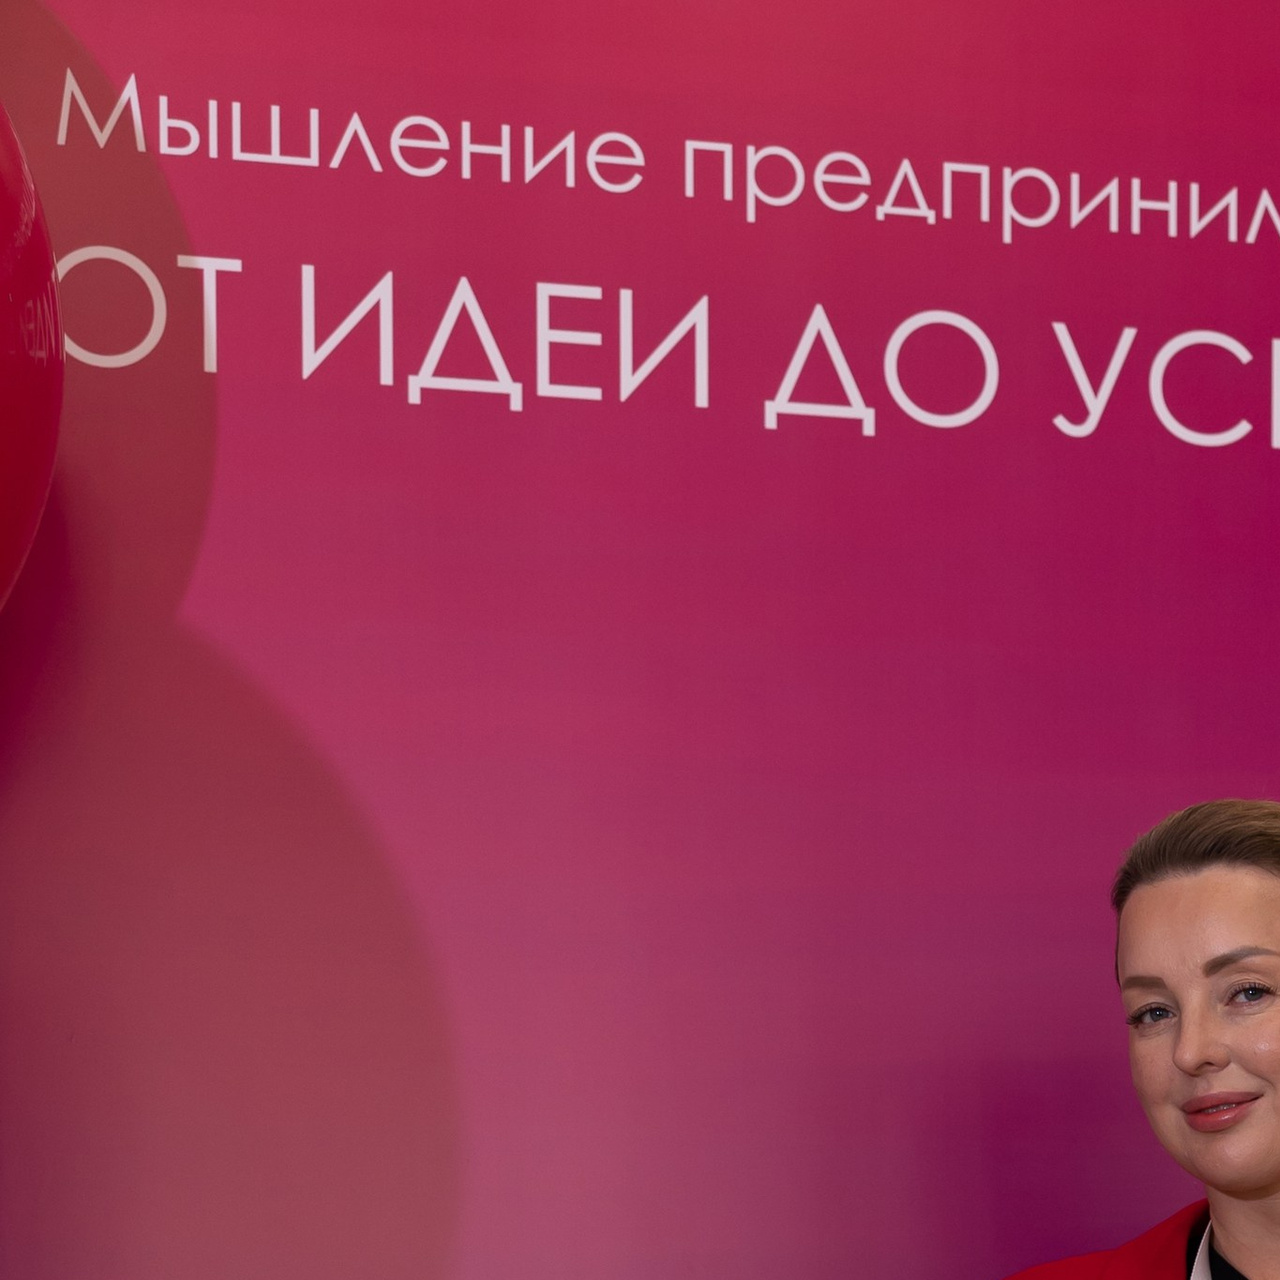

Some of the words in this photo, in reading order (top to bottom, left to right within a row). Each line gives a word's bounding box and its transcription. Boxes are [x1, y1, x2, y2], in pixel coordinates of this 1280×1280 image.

[56, 67, 646, 193] Мышление
[53, 244, 243, 374] ОТ
[301, 263, 709, 412] ИДЕИ
[764, 303, 1000, 437] ДО
